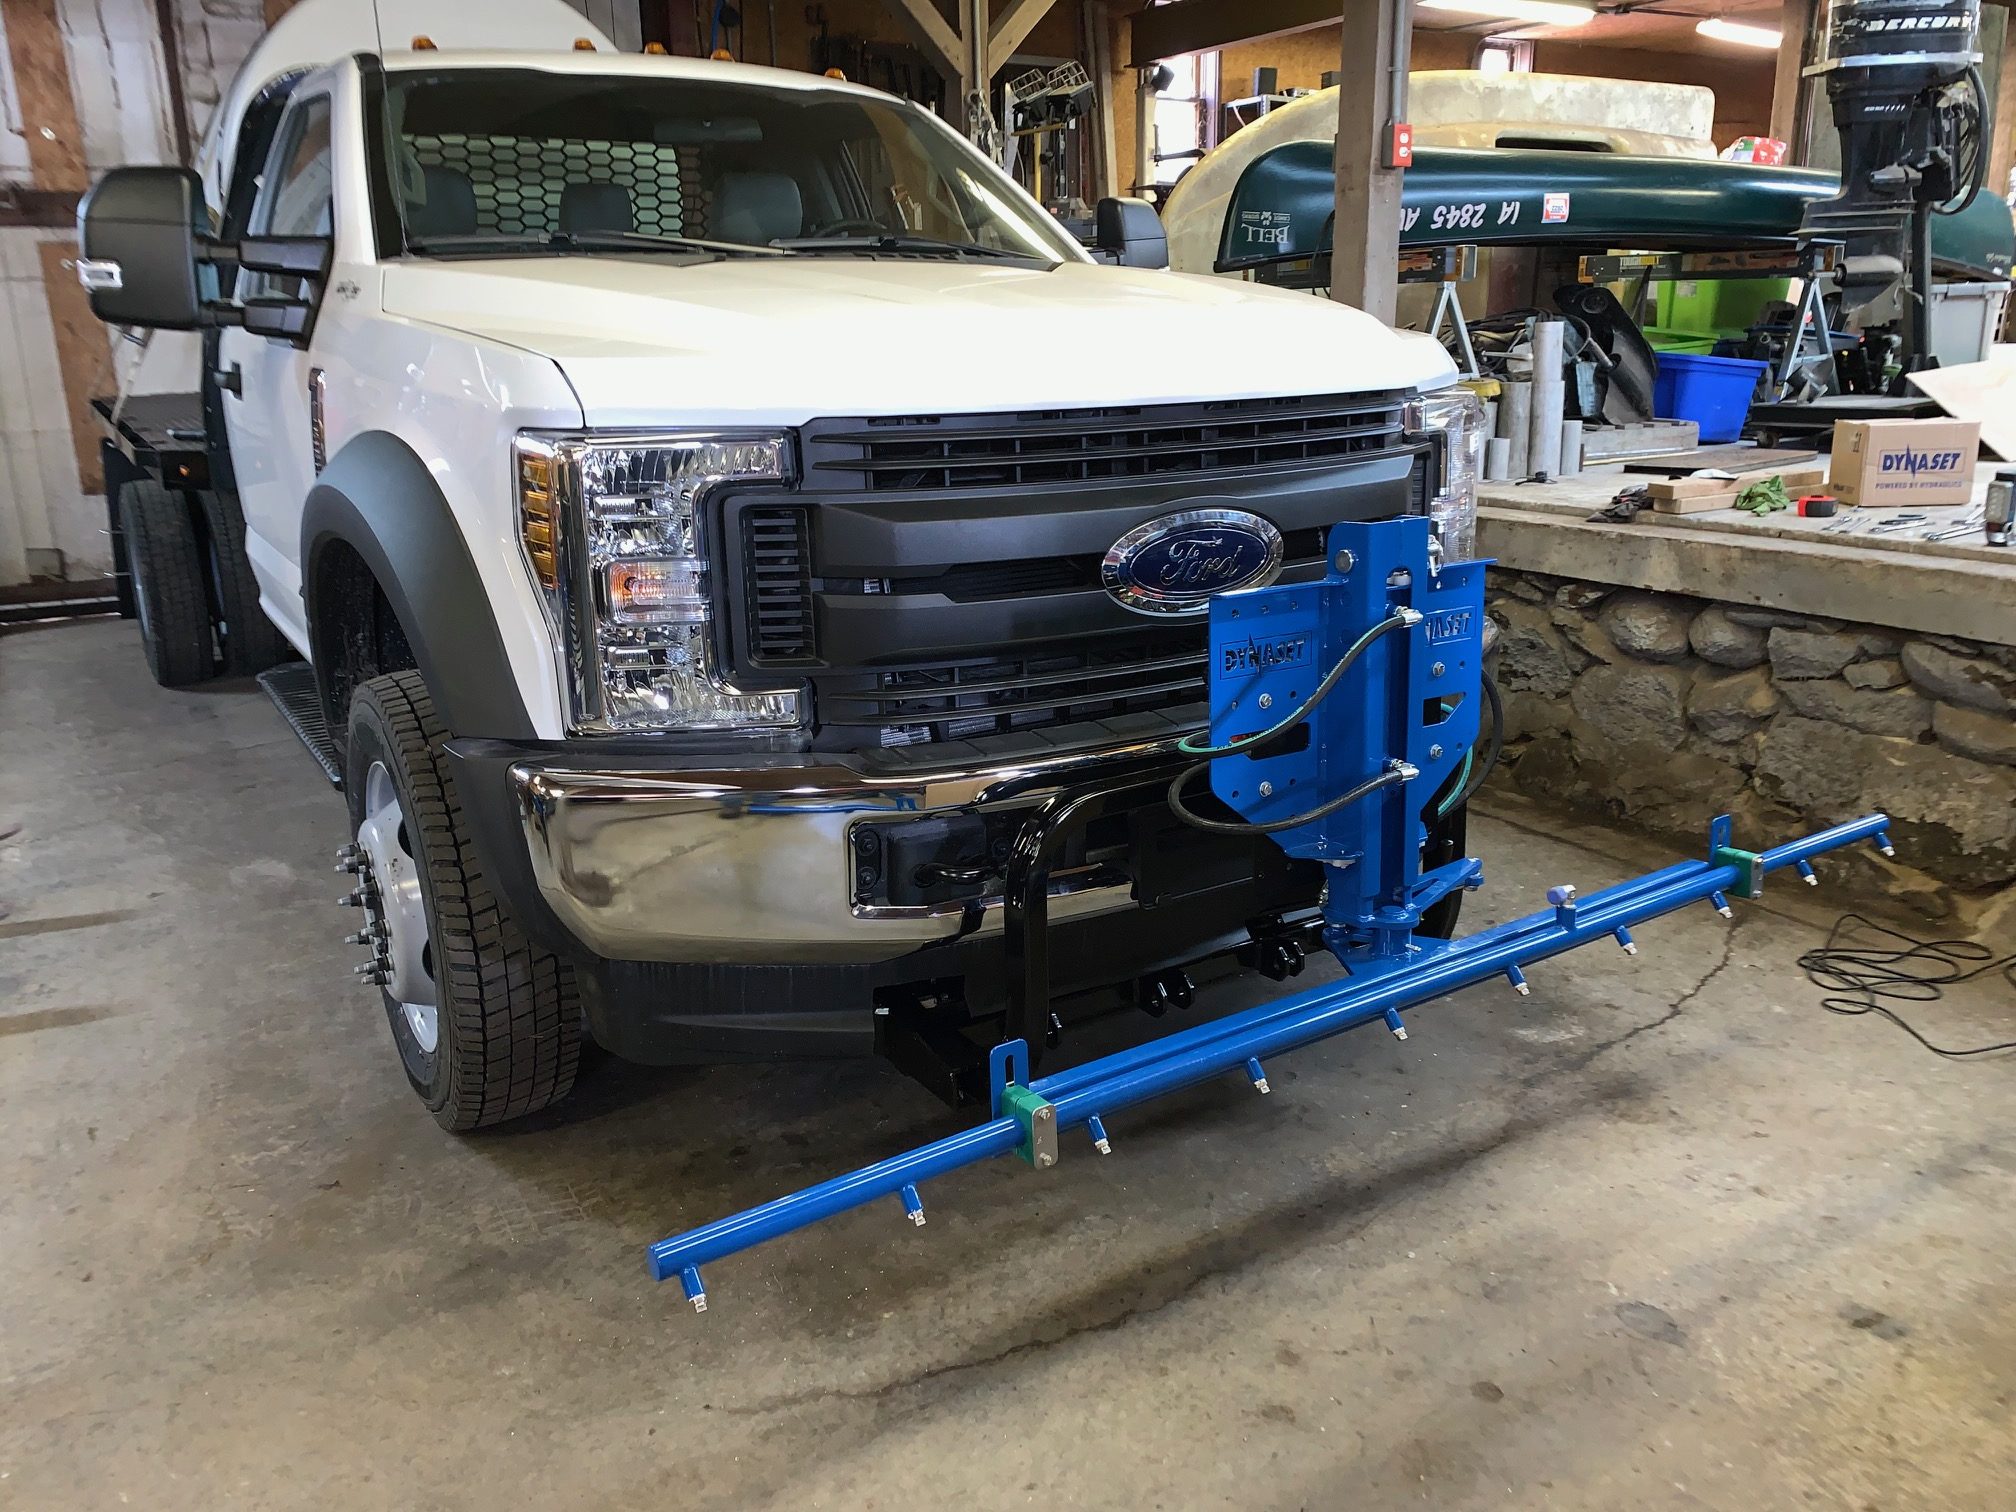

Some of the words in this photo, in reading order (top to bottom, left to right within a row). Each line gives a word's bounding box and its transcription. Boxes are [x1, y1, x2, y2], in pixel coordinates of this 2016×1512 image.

[1431, 203, 1487, 230] 2845
[1497, 201, 1520, 225] IA
[1241, 223, 1290, 244] BELL
[1882, 445, 1961, 478] DYNASET
[1909, 481, 1919, 489] BY
[1160, 535, 1244, 586] Ford
[1225, 633, 1306, 678] DYNASET
